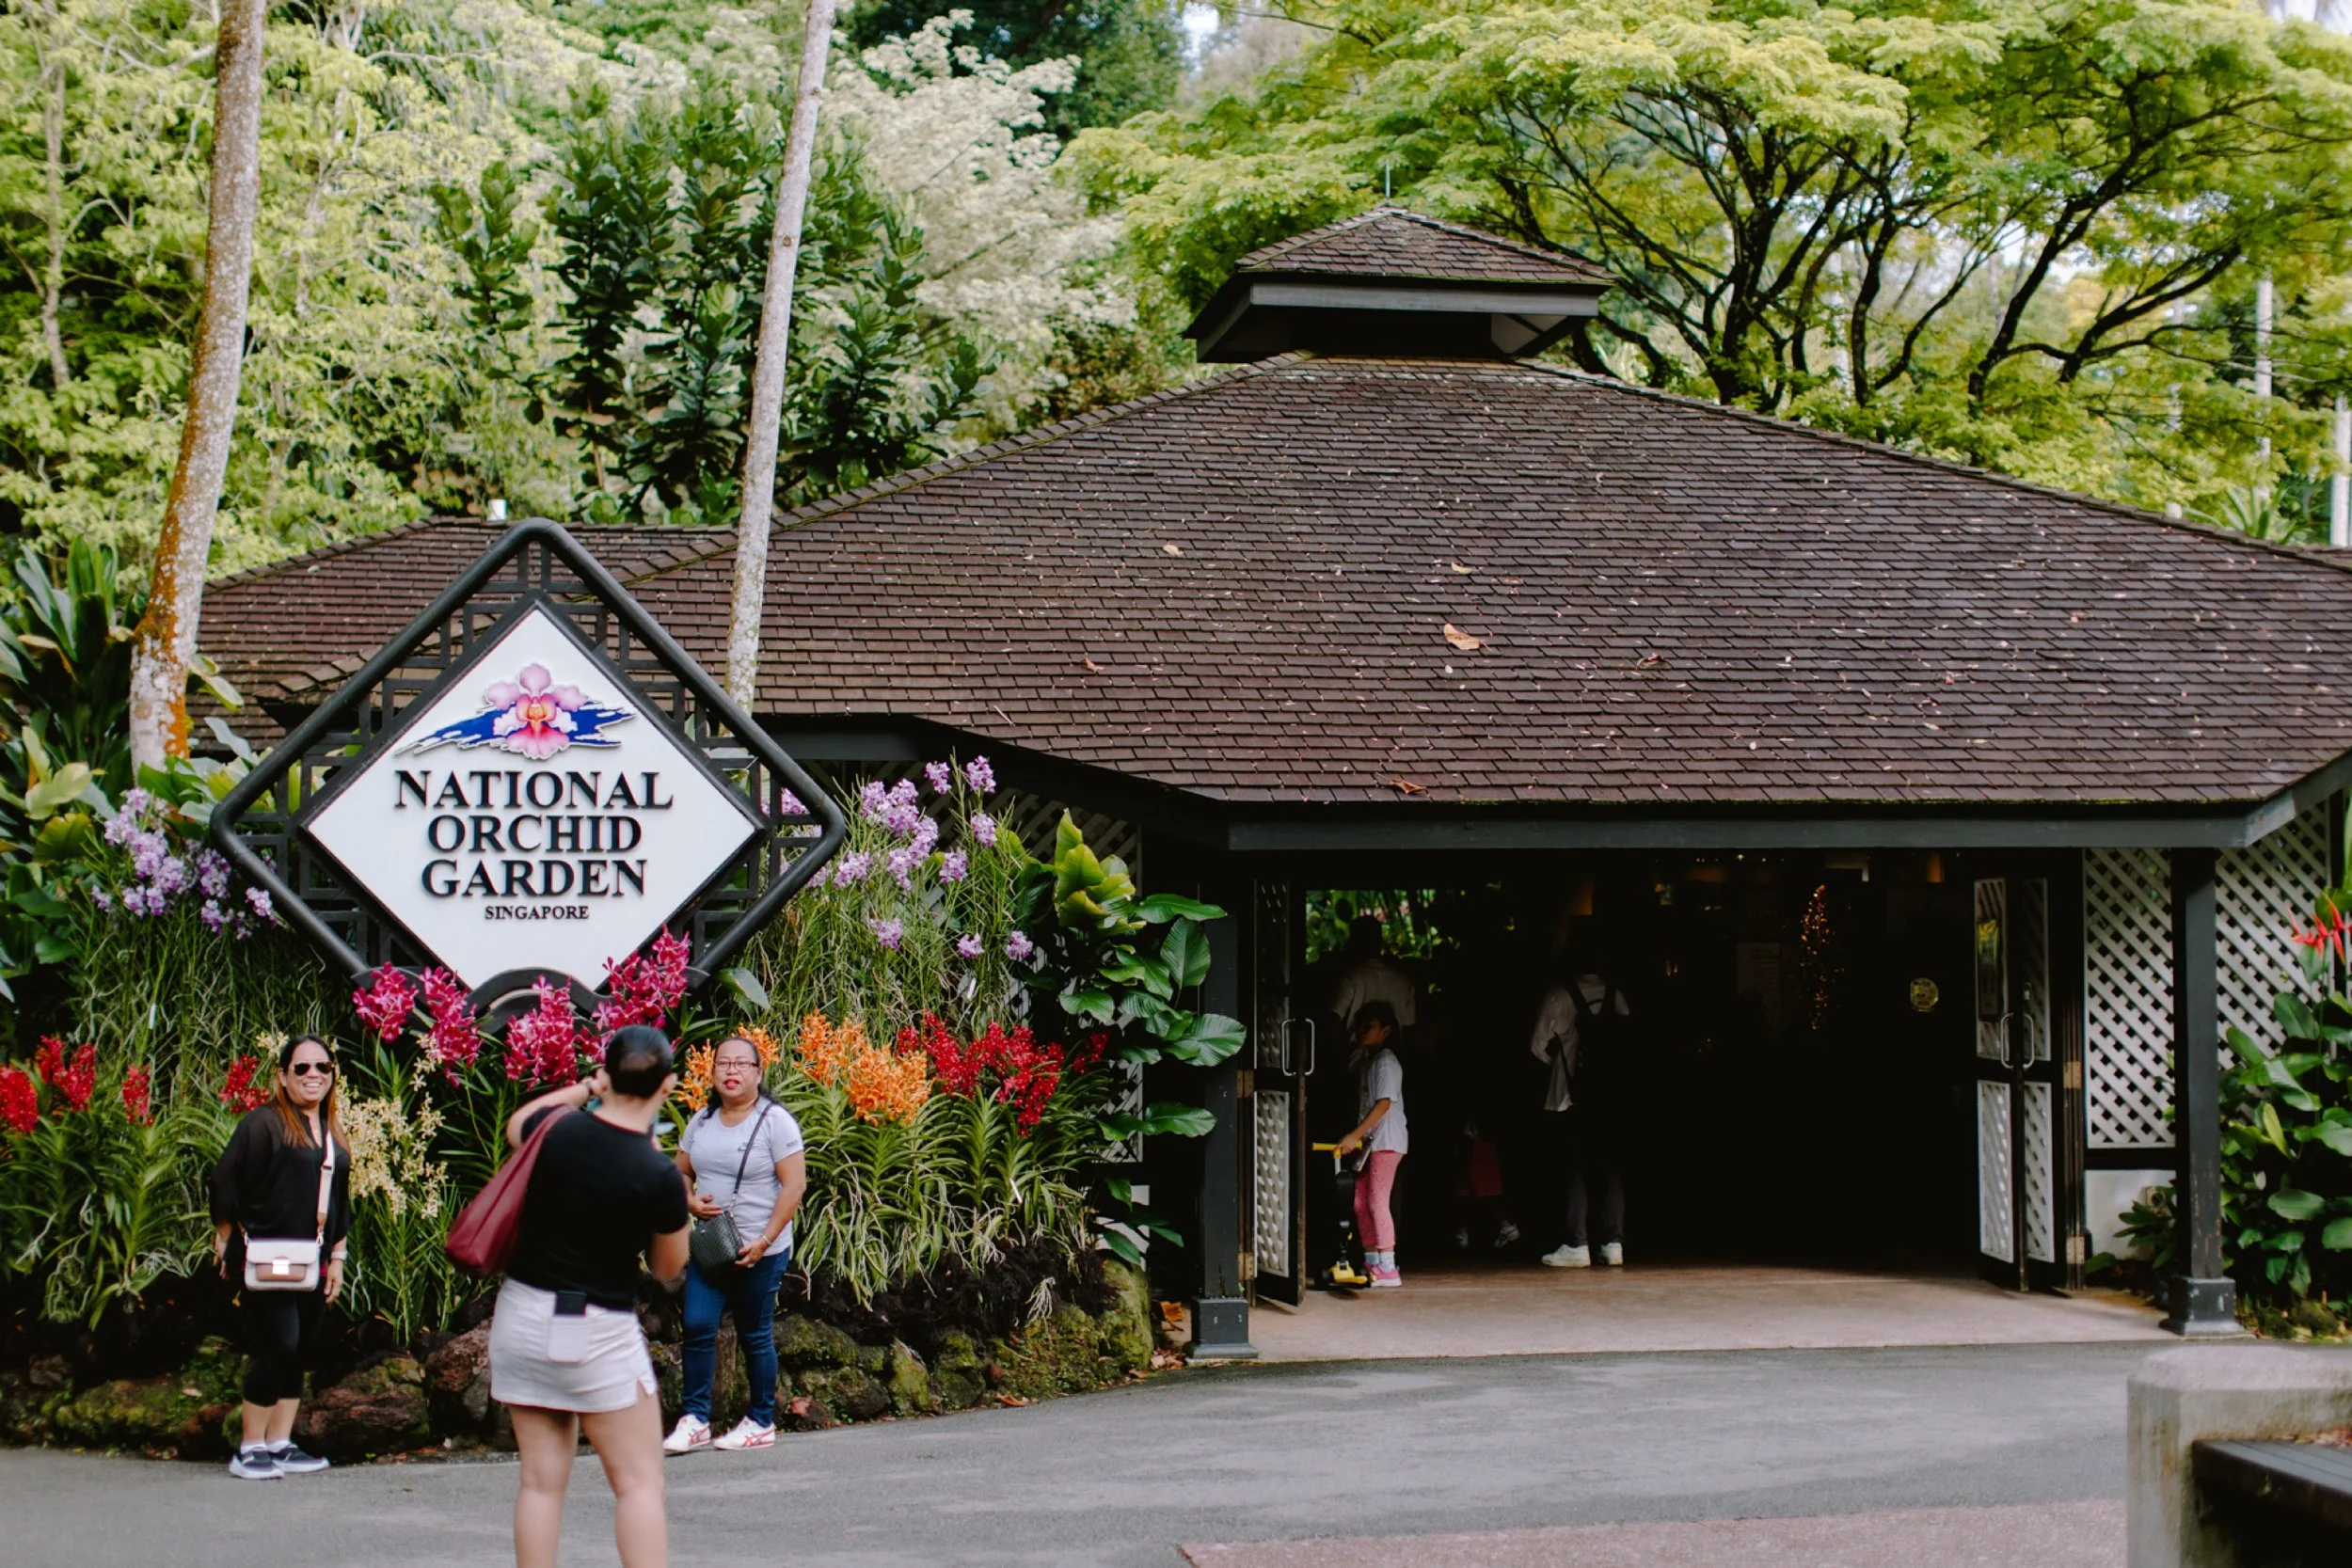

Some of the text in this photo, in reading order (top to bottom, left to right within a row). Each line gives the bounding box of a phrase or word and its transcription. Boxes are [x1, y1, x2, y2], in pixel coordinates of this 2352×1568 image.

[394, 769, 674, 811] NATIONAL
[427, 814, 643, 855] ORCHID
[421, 859, 647, 899] GARDEN
[485, 905, 590, 920] SINGAPORE
